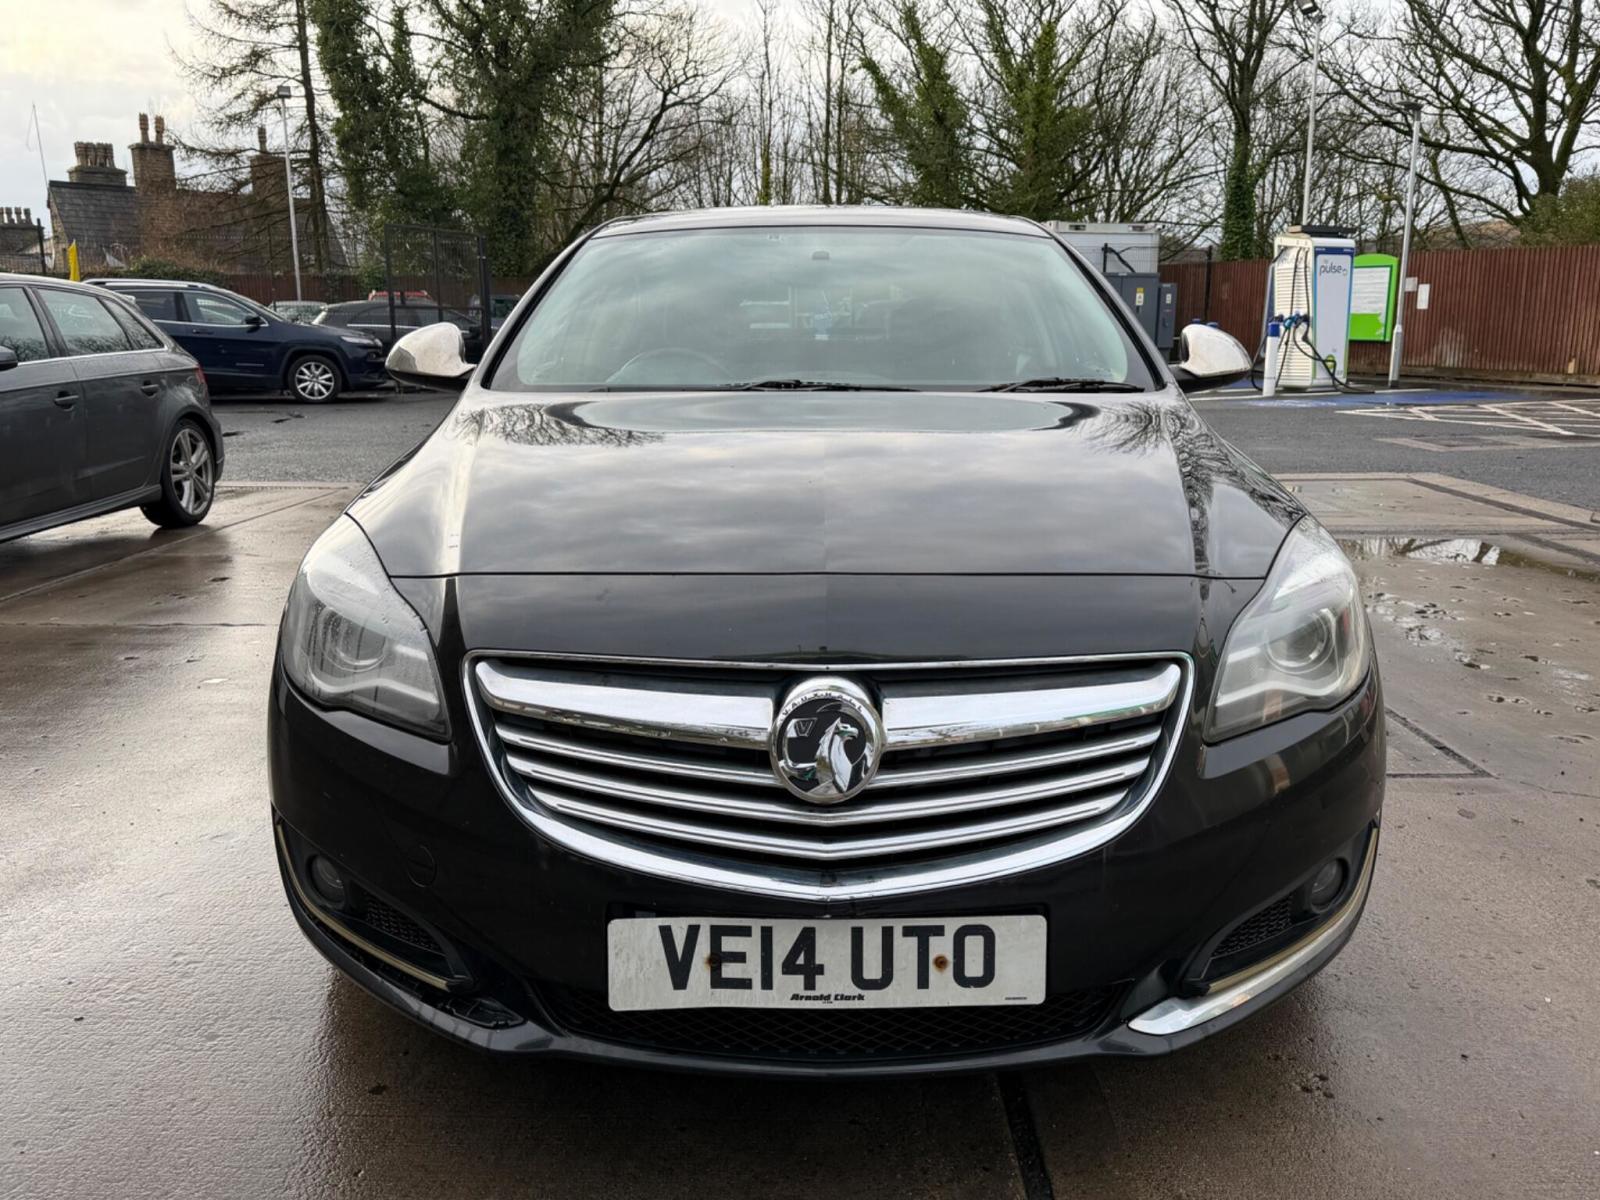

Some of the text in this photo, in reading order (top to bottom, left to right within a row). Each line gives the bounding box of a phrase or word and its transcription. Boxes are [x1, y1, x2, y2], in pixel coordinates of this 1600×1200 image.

[1320, 262, 1342, 276] pulse
[658, 924, 996, 991] VE14 UTO
[790, 993, 865, 1001] Arnold Clark
